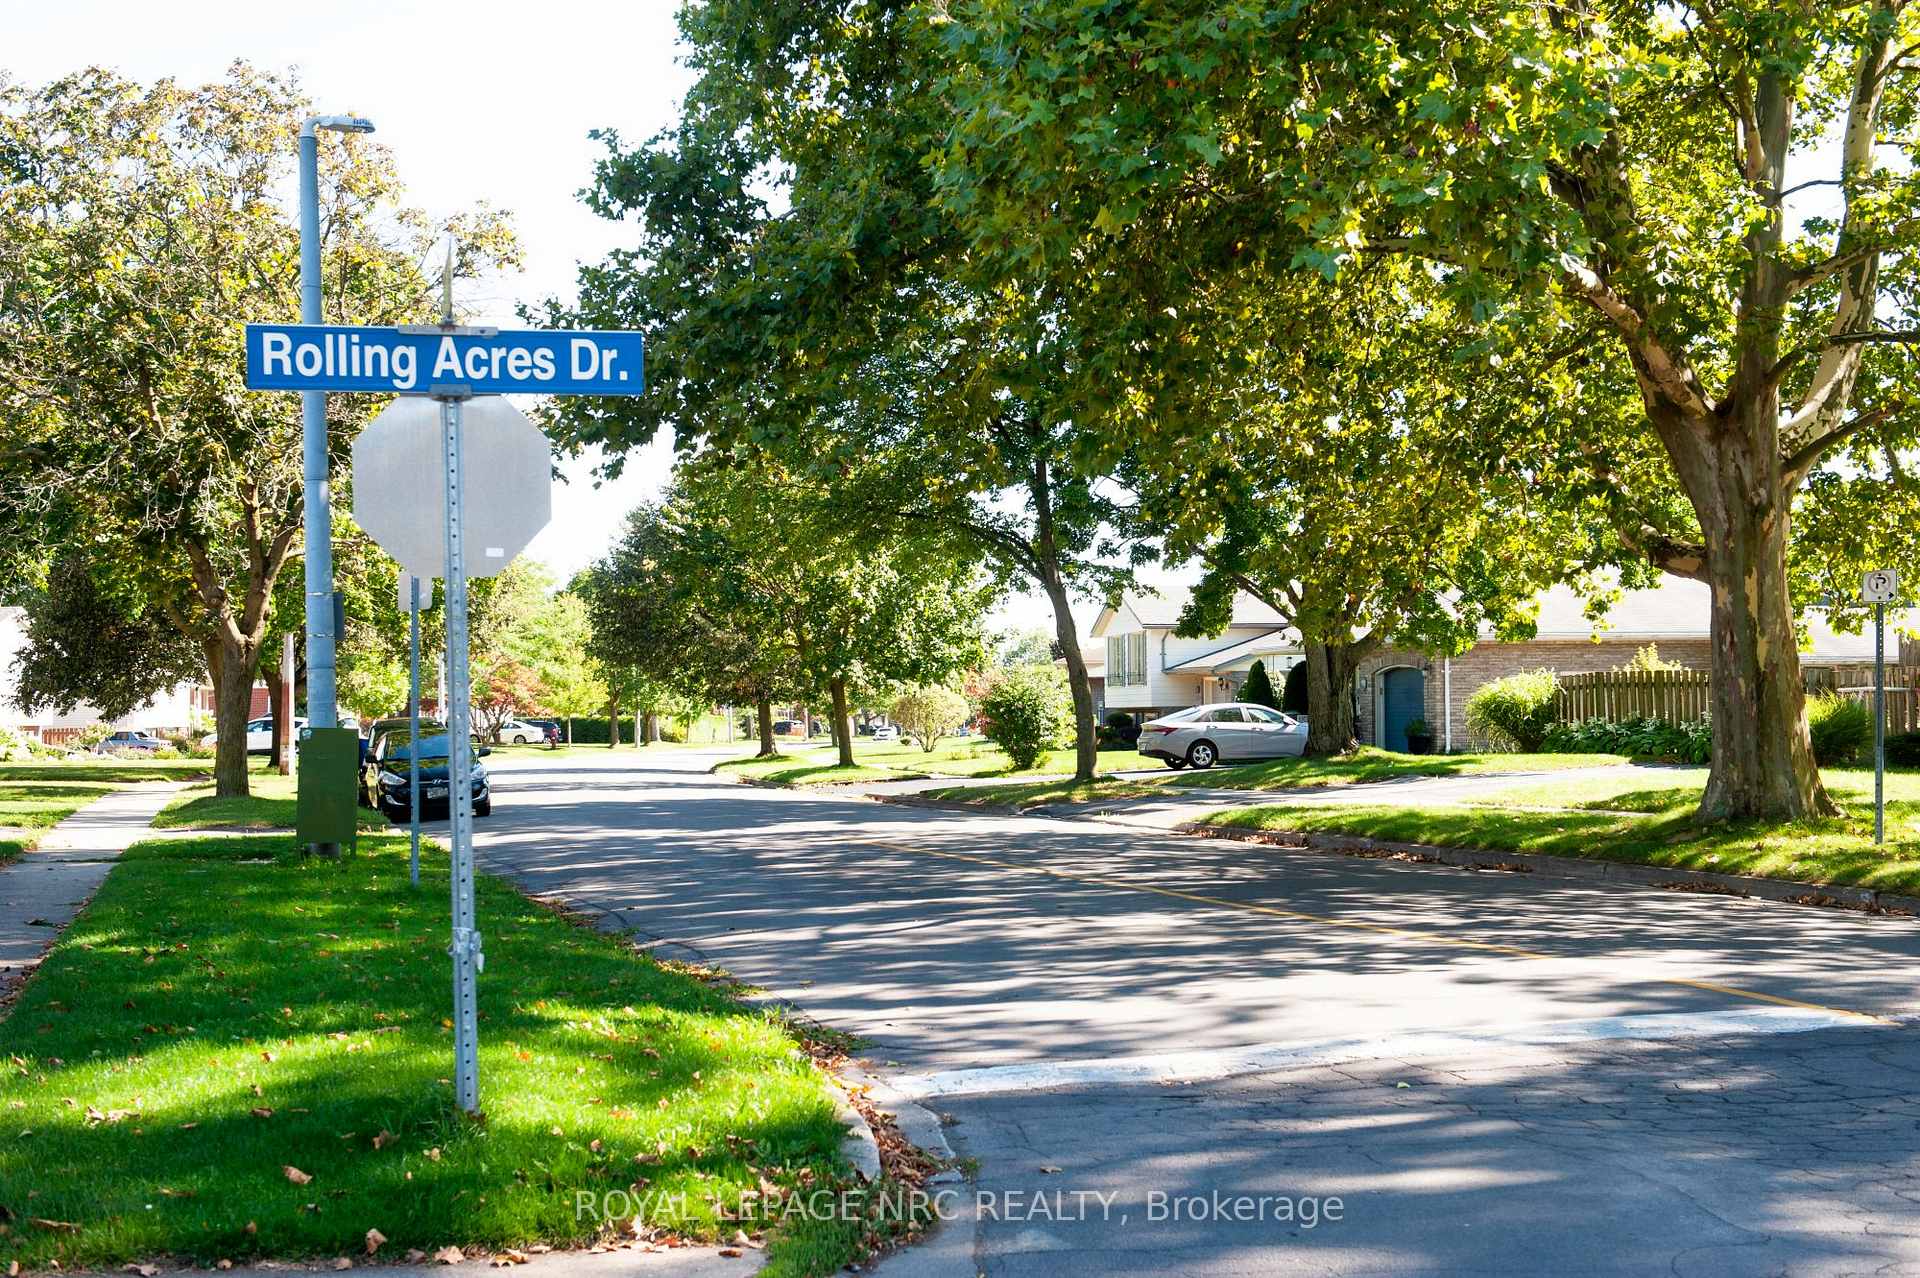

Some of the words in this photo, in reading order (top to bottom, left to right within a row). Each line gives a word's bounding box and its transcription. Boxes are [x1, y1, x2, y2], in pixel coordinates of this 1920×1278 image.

[262, 332, 417, 389] Rolling
[432, 336, 556, 380] Acres
[570, 338, 629, 381] Dr.
